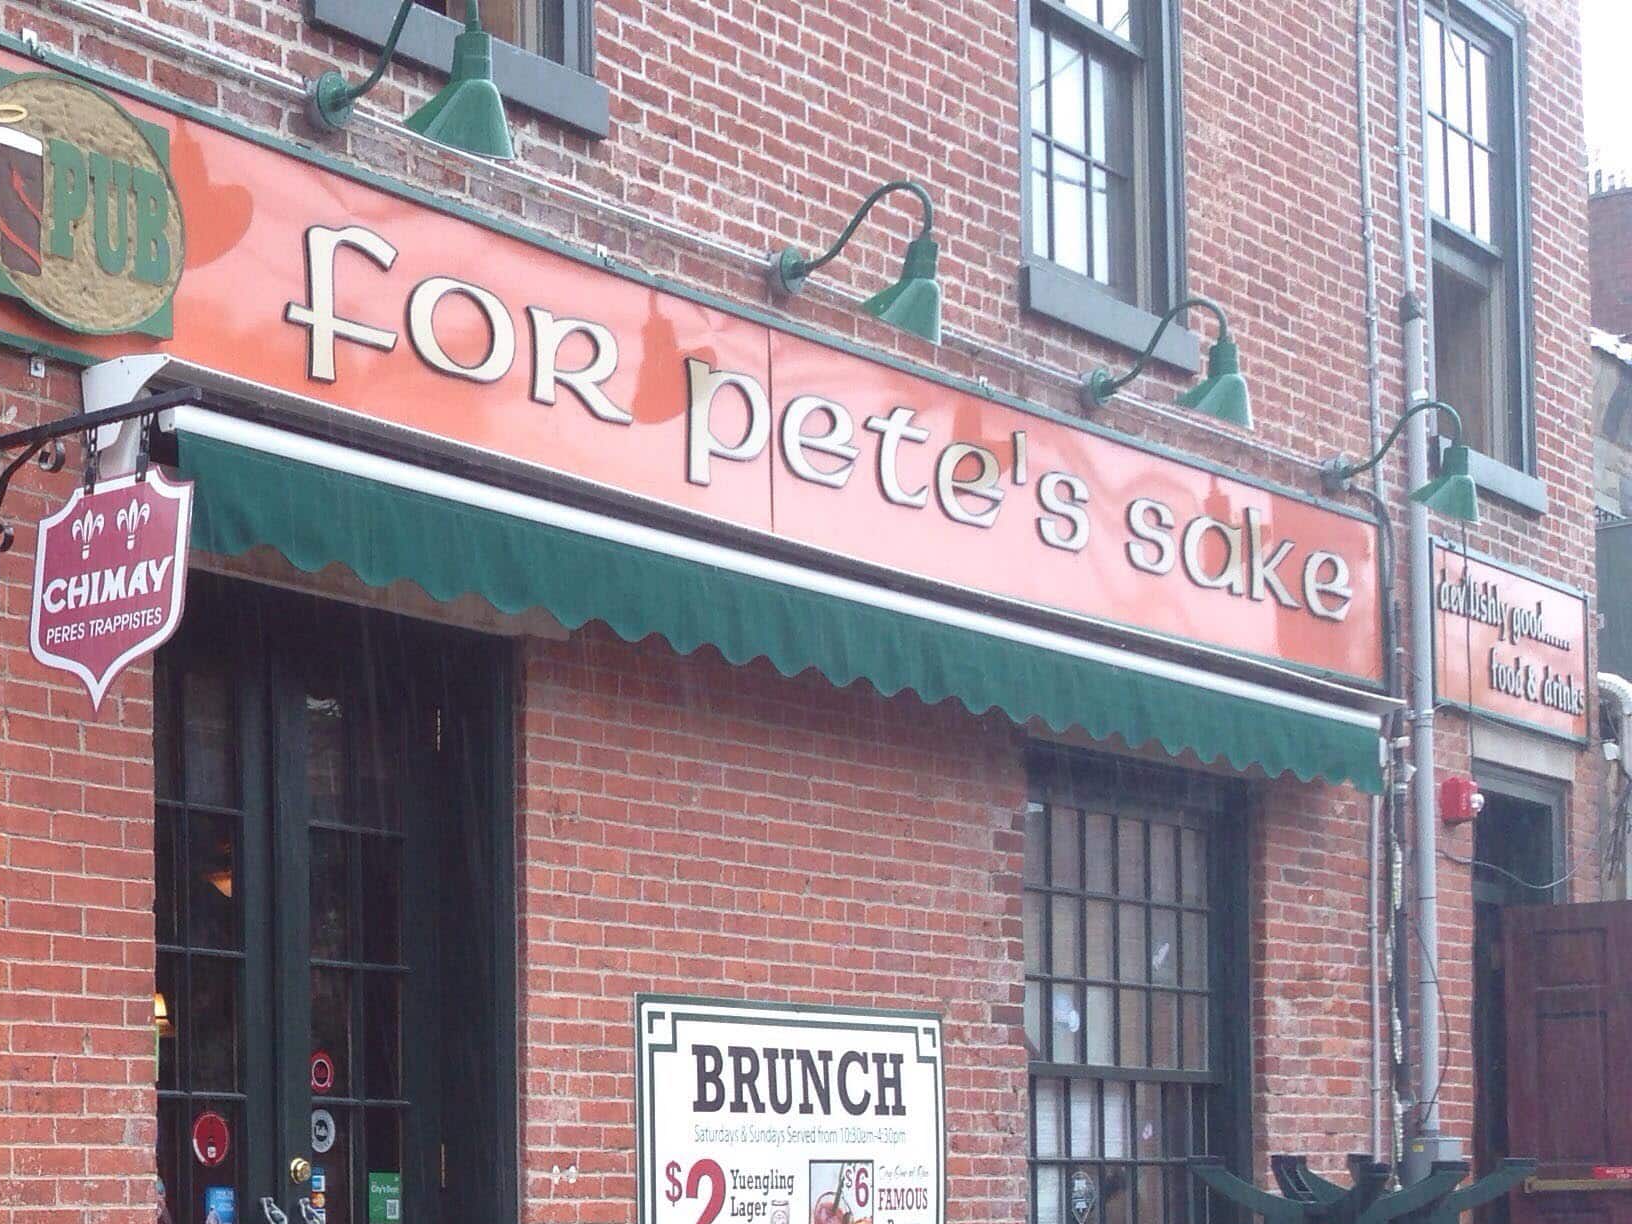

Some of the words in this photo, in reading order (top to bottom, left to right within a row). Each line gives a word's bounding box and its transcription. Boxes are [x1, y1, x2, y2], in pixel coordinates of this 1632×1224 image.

[49, 138, 169, 287] PUB
[686, 357, 1091, 552] pete's
[1125, 496, 1354, 621] sake
[43, 556, 174, 614] CHIMAY
[46, 622, 85, 645] PERES
[90, 607, 163, 637] TRAPPISTES
[1490, 645, 1524, 698] food
[1543, 664, 1584, 716] drinks
[691, 1043, 907, 1117] BRUNCH
[694, 1124, 739, 1147] Saturdays
[749, 1124, 784, 1147] Sundays
[786, 1125, 816, 1144] Served
[730, 1169, 795, 1196] Yuengling
[878, 1188, 928, 1211] FAMOUS
[730, 1196, 767, 1222] Lager
